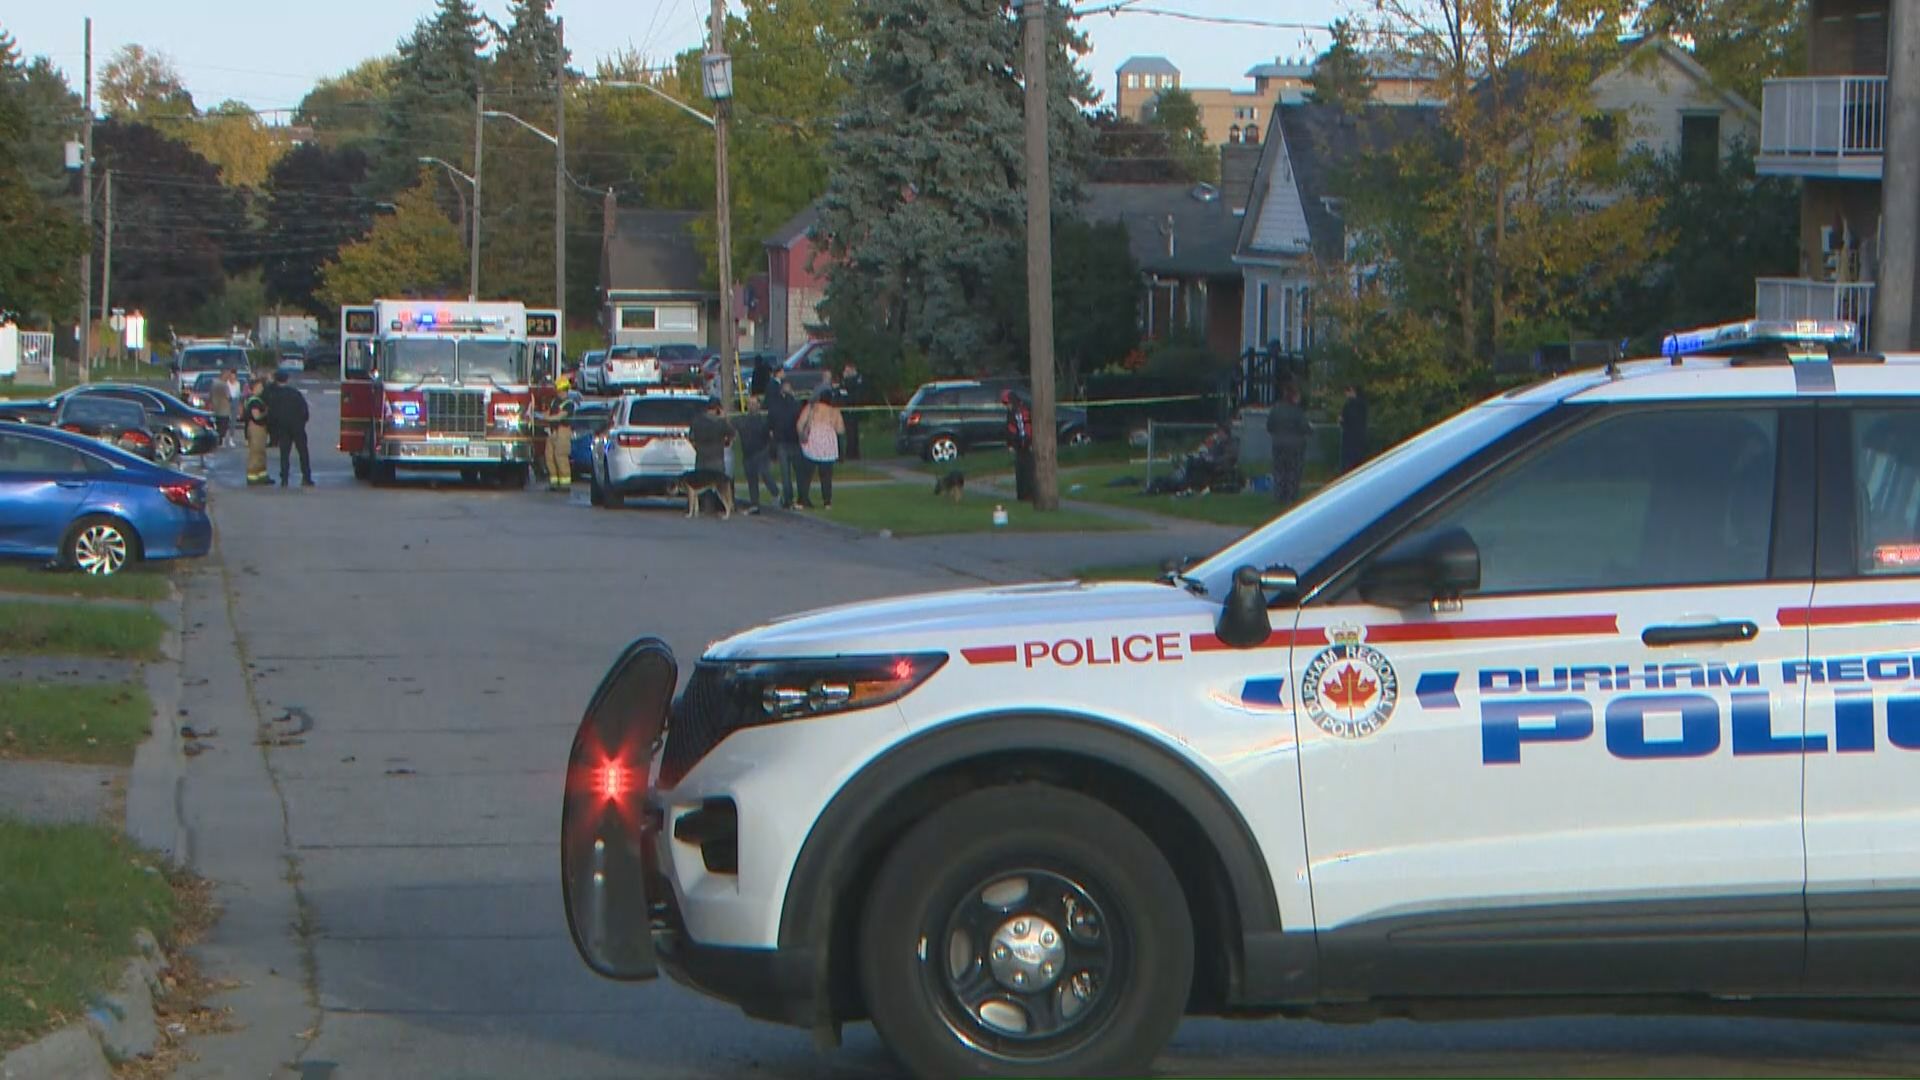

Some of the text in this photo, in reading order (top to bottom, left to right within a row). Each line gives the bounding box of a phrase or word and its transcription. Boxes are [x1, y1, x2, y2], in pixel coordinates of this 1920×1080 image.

[528, 318, 552, 334] P21
[1024, 632, 1183, 668] POLICE
[1304, 645, 1396, 718] DURHAM REGIONAL
[1479, 661, 1760, 694] DURHAM
[1322, 717, 1378, 738] POLICE
